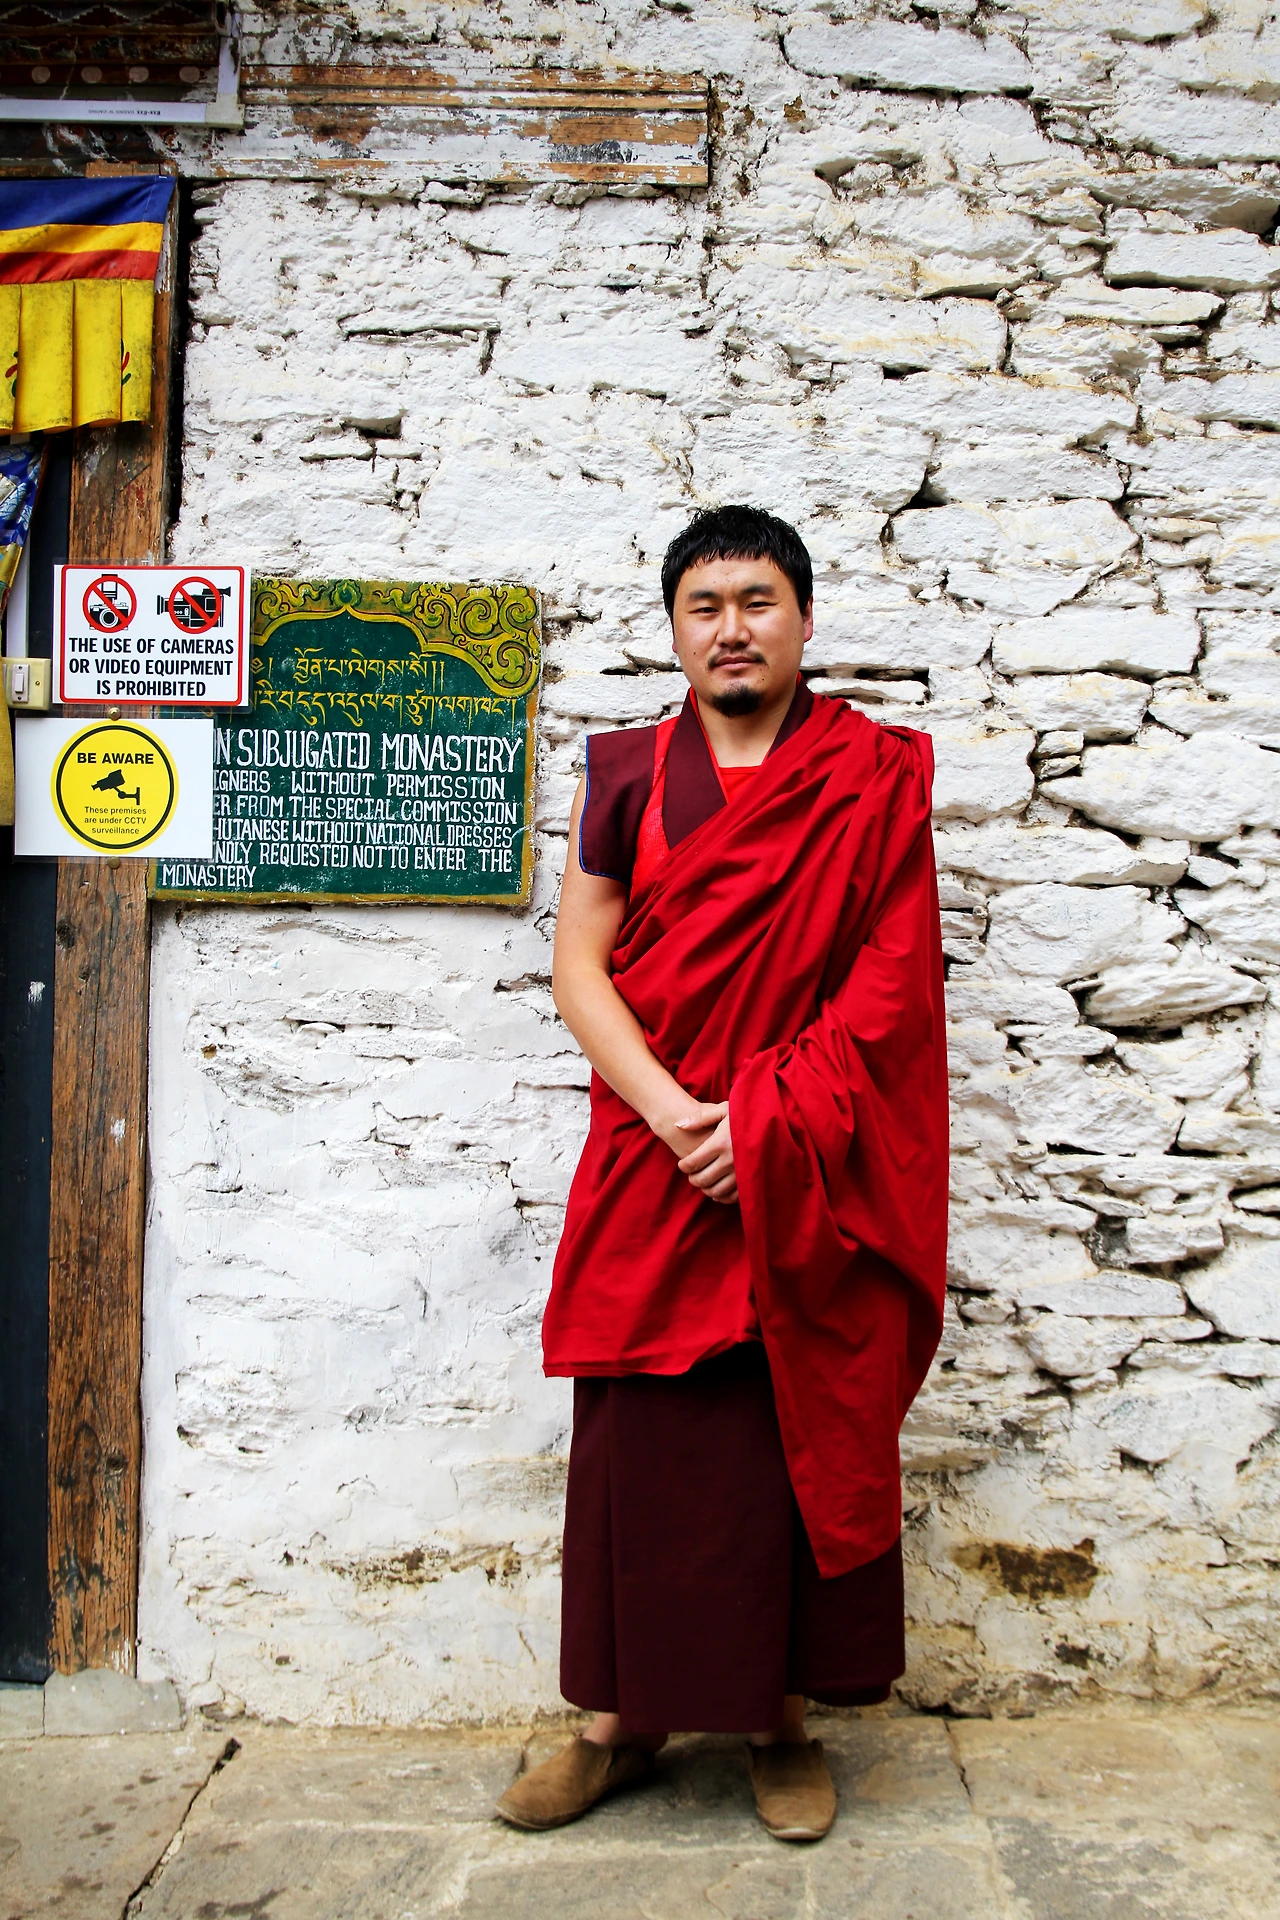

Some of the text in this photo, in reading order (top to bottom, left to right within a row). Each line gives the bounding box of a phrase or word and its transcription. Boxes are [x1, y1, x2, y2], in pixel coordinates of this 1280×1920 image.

[69, 637, 234, 655] THE USE OF CAMERAS
[69, 658, 233, 677] OR VIDEO EQUIPMENT
[96, 680, 206, 697] IS PROHIBITED
[77, 752, 154, 765] BE AWARE
[213, 728, 523, 773] N SUBJUGATED MONASTERY
[291, 771, 375, 796] WITHOUT
[386, 773, 506, 800] PERMISSION
[84, 806, 147, 816] These premises
[236, 795, 284, 818] FROM
[288, 796, 322, 819] THE
[325, 797, 396, 821] SPECIAL
[400, 800, 518, 825] COMMISSION
[291, 820, 365, 844] WITHOUT
[366, 822, 445, 847] NATIONAL
[446, 824, 513, 849] DRESSES
[259, 842, 349, 868] REQUESTED
[352, 845, 388, 869] NOT
[388, 845, 409, 870] TO
[414, 846, 467, 871] ENTER
[478, 849, 513, 873] THE
[162, 864, 257, 888] MONASTERY
